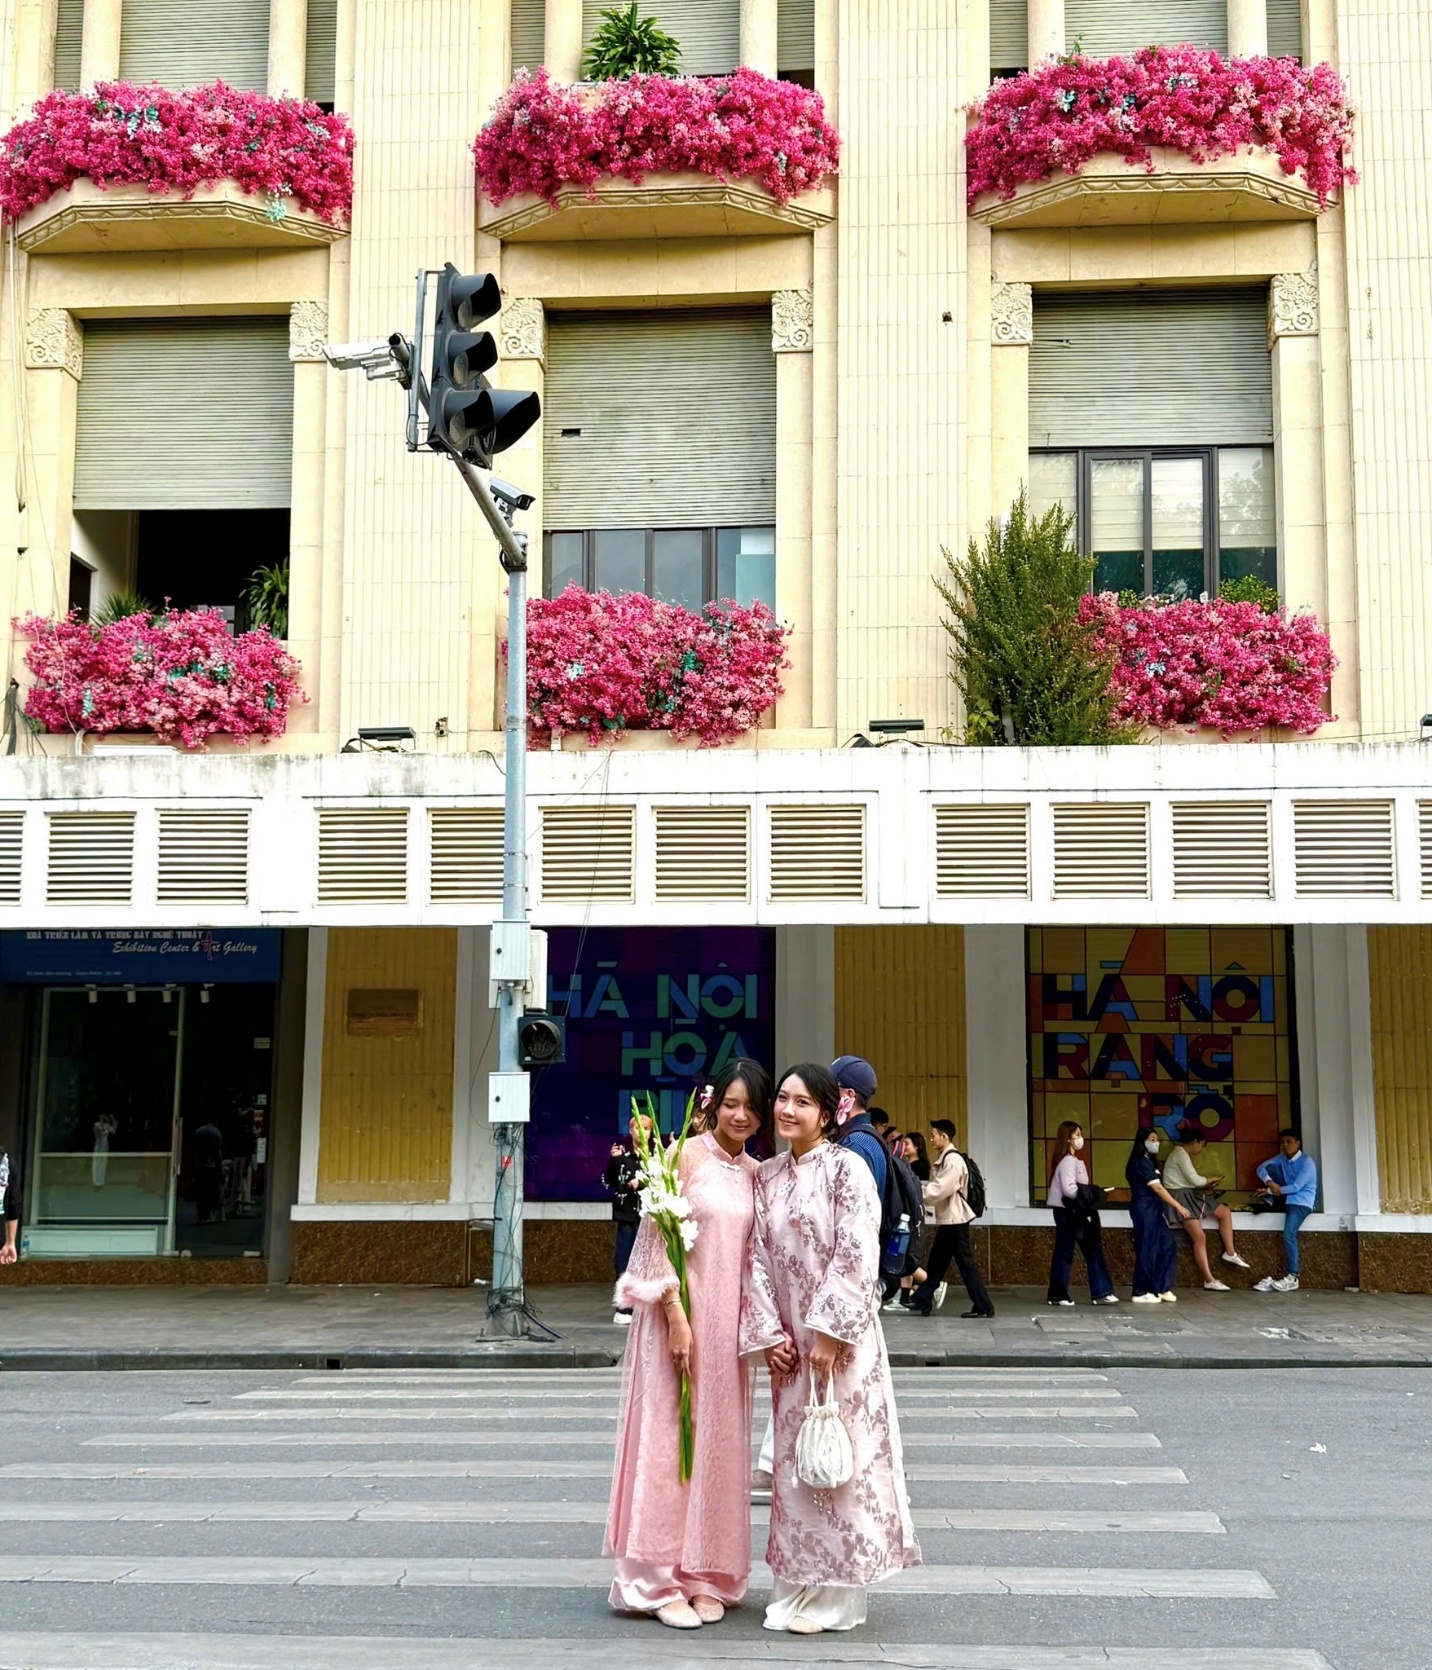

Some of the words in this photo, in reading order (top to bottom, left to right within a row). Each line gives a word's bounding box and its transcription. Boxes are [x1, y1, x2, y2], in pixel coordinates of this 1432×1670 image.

[112, 941, 158, 954] Exhibition
[159, 941, 190, 954] Center
[191, 941, 200, 952] &
[222, 941, 258, 955] Gallery
[657, 961, 759, 1030] NỘI
[1043, 961, 1139, 1021] HÀ
[1165, 961, 1275, 1035] NỘI
[1043, 1033, 1234, 1088] RẠNG
